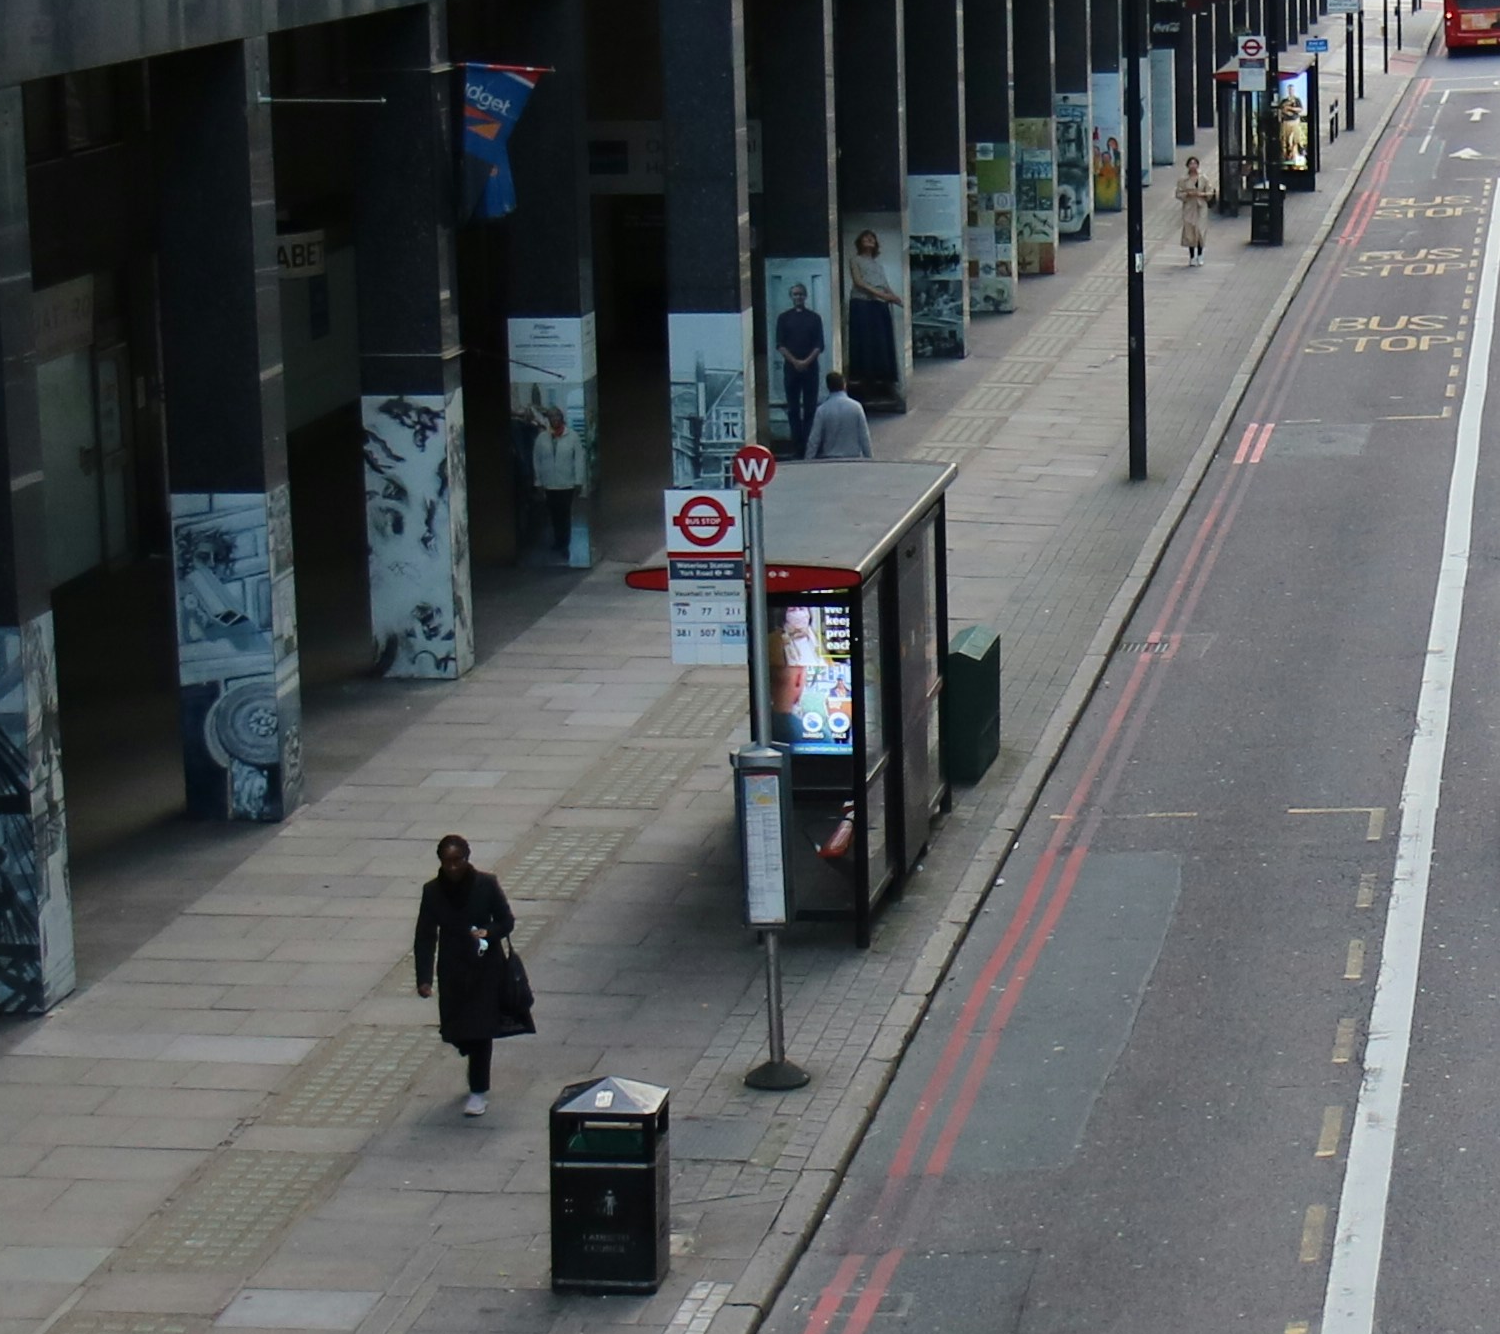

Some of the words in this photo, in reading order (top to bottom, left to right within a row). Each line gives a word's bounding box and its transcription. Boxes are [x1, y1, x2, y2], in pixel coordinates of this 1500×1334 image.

[1379, 194, 1474, 207] BUS
[1372, 207, 1484, 220] STOP
[1359, 247, 1463, 262] BUS
[1340, 262, 1471, 277] STOP
[1328, 315, 1449, 333] BUS
[1304, 335, 1456, 354] STOP
[737, 457, 769, 482] W
[685, 517, 700, 525] BUS
[701, 517, 721, 525] STOP
[676, 561, 708, 569] Waterloo
[708, 561, 735, 569] Station
[676, 607, 688, 616] 76
[701, 607, 713, 616] 77
[725, 607, 741, 616] 211
[676, 629, 691, 637] 381
[700, 629, 716, 637] 507
[722, 629, 746, 637] N381
